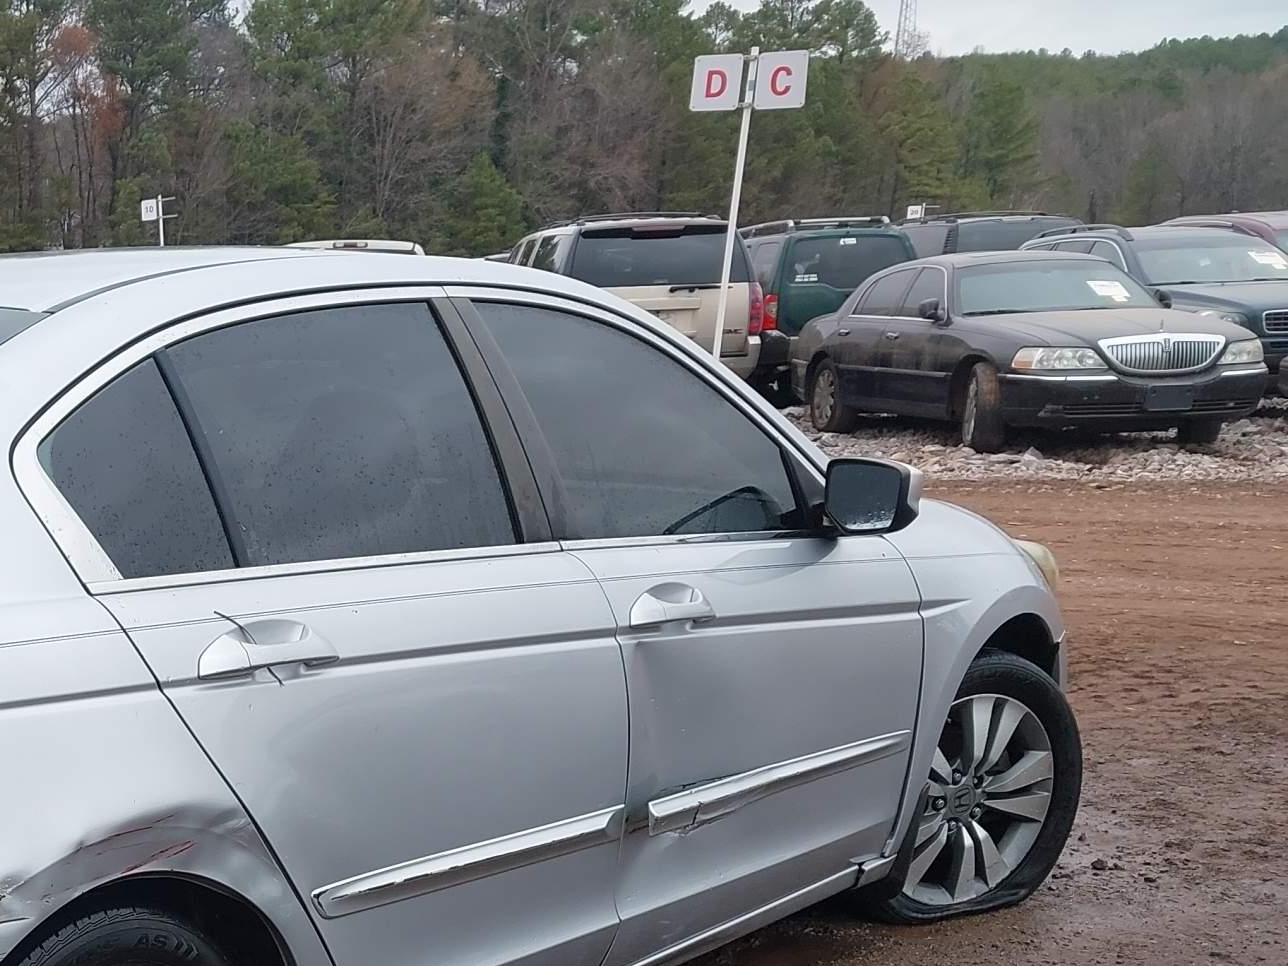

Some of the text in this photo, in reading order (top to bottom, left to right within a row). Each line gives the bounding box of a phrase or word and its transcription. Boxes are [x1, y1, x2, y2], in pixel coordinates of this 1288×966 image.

[704, 69, 728, 98] D
[770, 65, 793, 96] C
[145, 205, 154, 214] 10
